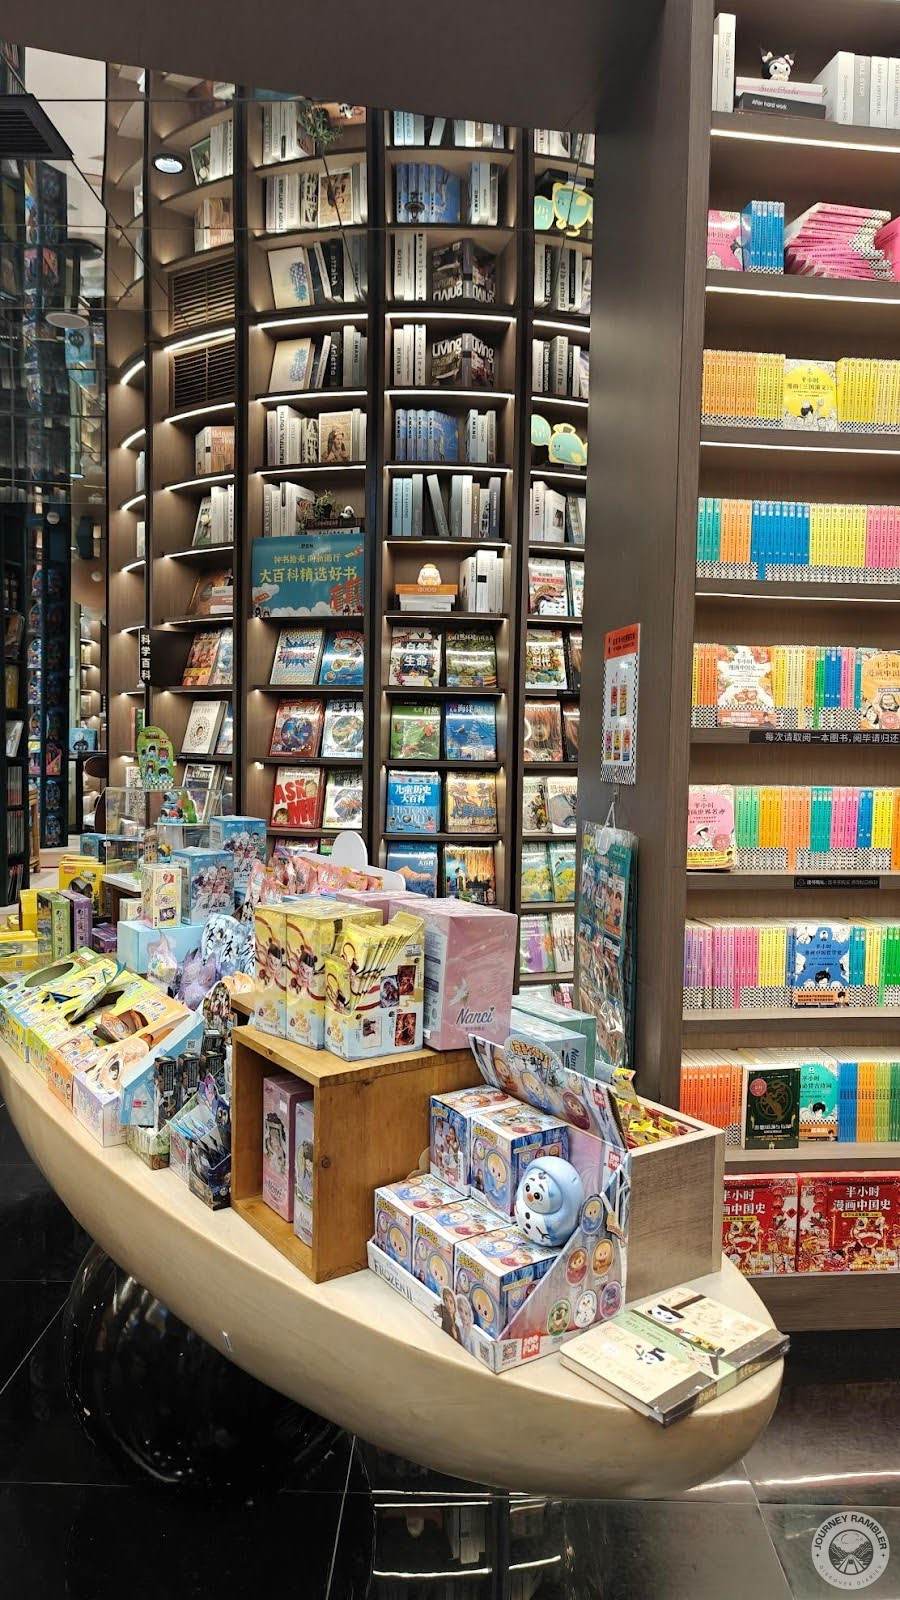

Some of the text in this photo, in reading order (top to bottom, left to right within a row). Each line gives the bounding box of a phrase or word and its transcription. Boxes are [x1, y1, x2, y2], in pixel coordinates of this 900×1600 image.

[260, 565, 357, 583] 大百科精选好书
[141, 634, 151, 681] 科学百科
[404, 655, 429, 667] 生命
[274, 778, 306, 804] ASK
[401, 794, 426, 804] 大百科
[456, 1005, 494, 1025] Nanci
[846, 1186, 880, 1198] 半小时
[833, 1199, 891, 1212] 漫画中国史
